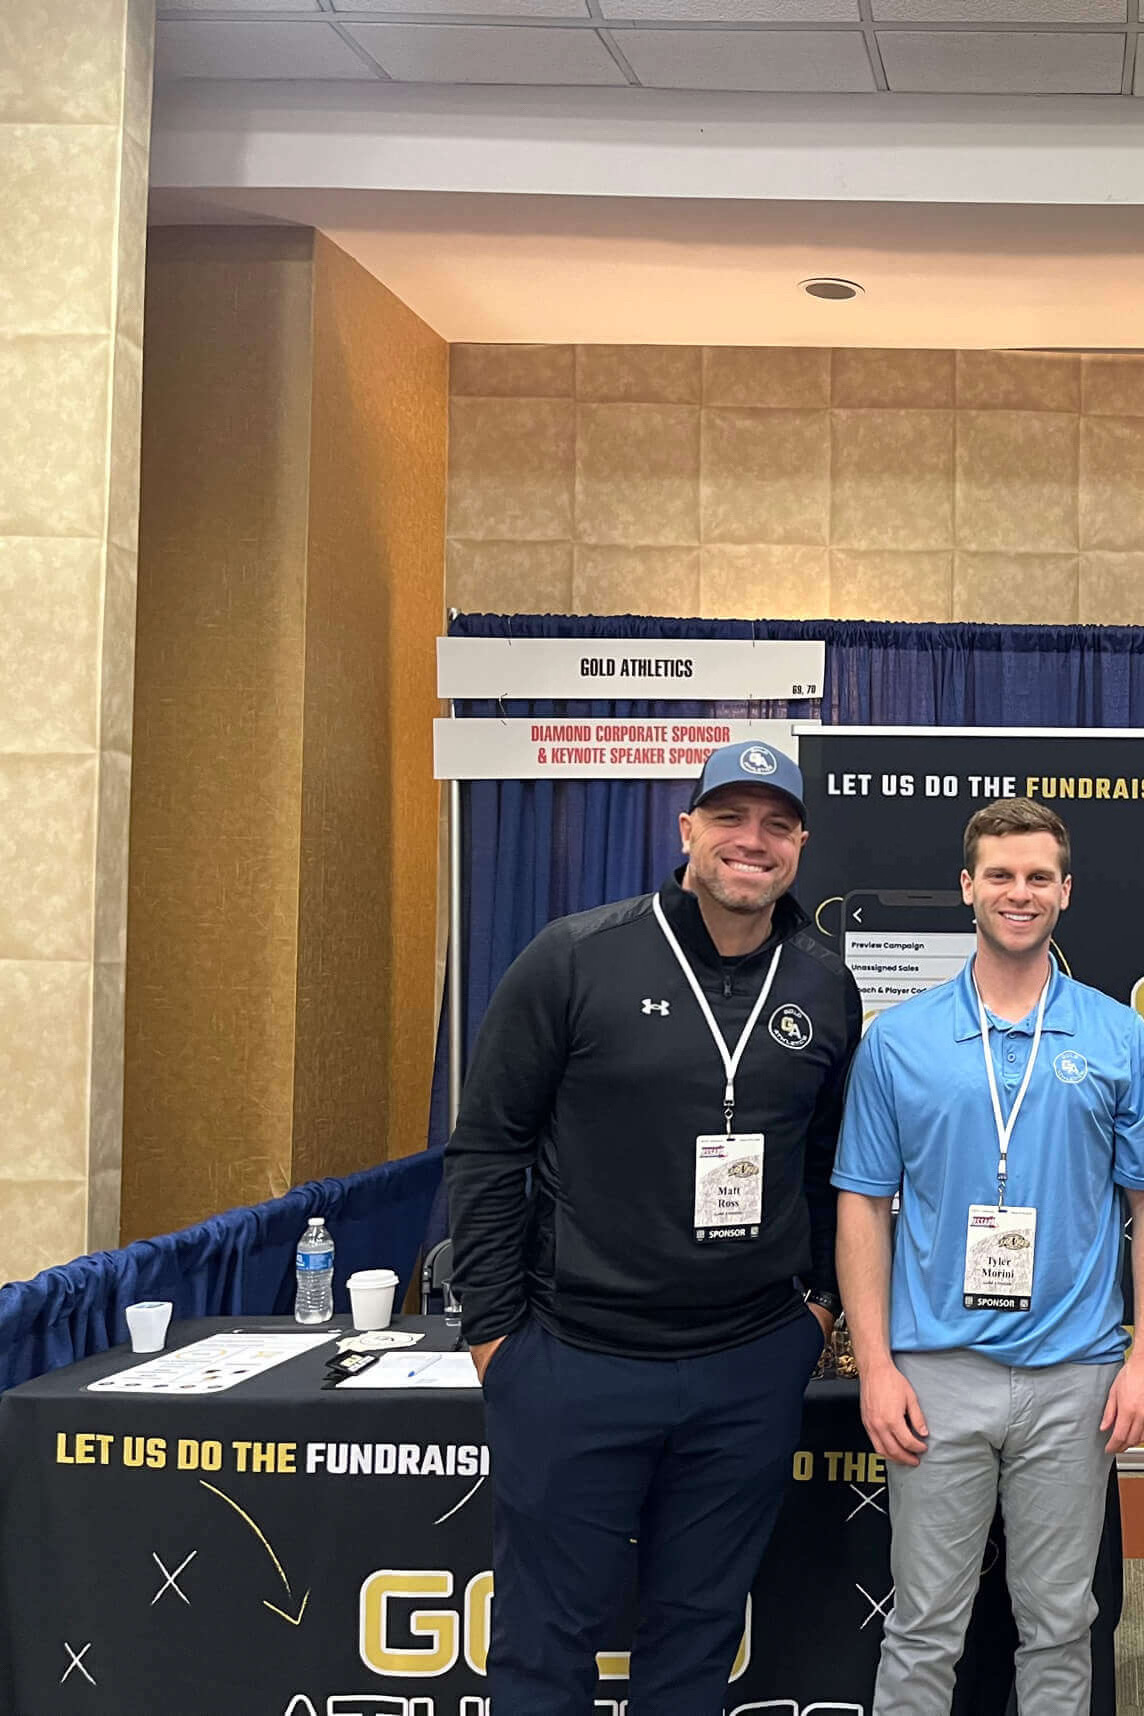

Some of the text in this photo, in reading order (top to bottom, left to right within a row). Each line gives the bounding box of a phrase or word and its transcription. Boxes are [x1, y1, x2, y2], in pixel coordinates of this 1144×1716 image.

[580, 658, 693, 678] GOLD ATHLETICS
[806, 684, 816, 694] 70
[531, 725, 731, 743] DIAMOND CORPORATE SPONSOR
[537, 748, 719, 764] & KEYNOTE SPEAKER SPONS
[827, 774, 872, 795] LET
[881, 775, 915, 796] US
[925, 775, 958, 797] DO
[968, 776, 1017, 798] THE
[883, 942, 925, 951] Campaign
[851, 964, 897, 973] Unassigned
[858, 986, 877, 994] oach
[885, 986, 909, 996] Player
[718, 1186, 740, 1196] Matt
[718, 1199, 740, 1209] Ross
[708, 1228, 746, 1239] SPONSOR
[987, 1256, 1012, 1269] Tyler
[982, 1268, 1015, 1279] Morini
[977, 1298, 1015, 1308] SPONSOR
[56, 1432, 490, 1477] LET US DO THE FUNDRAISI
[824, 1451, 887, 1483] THE
